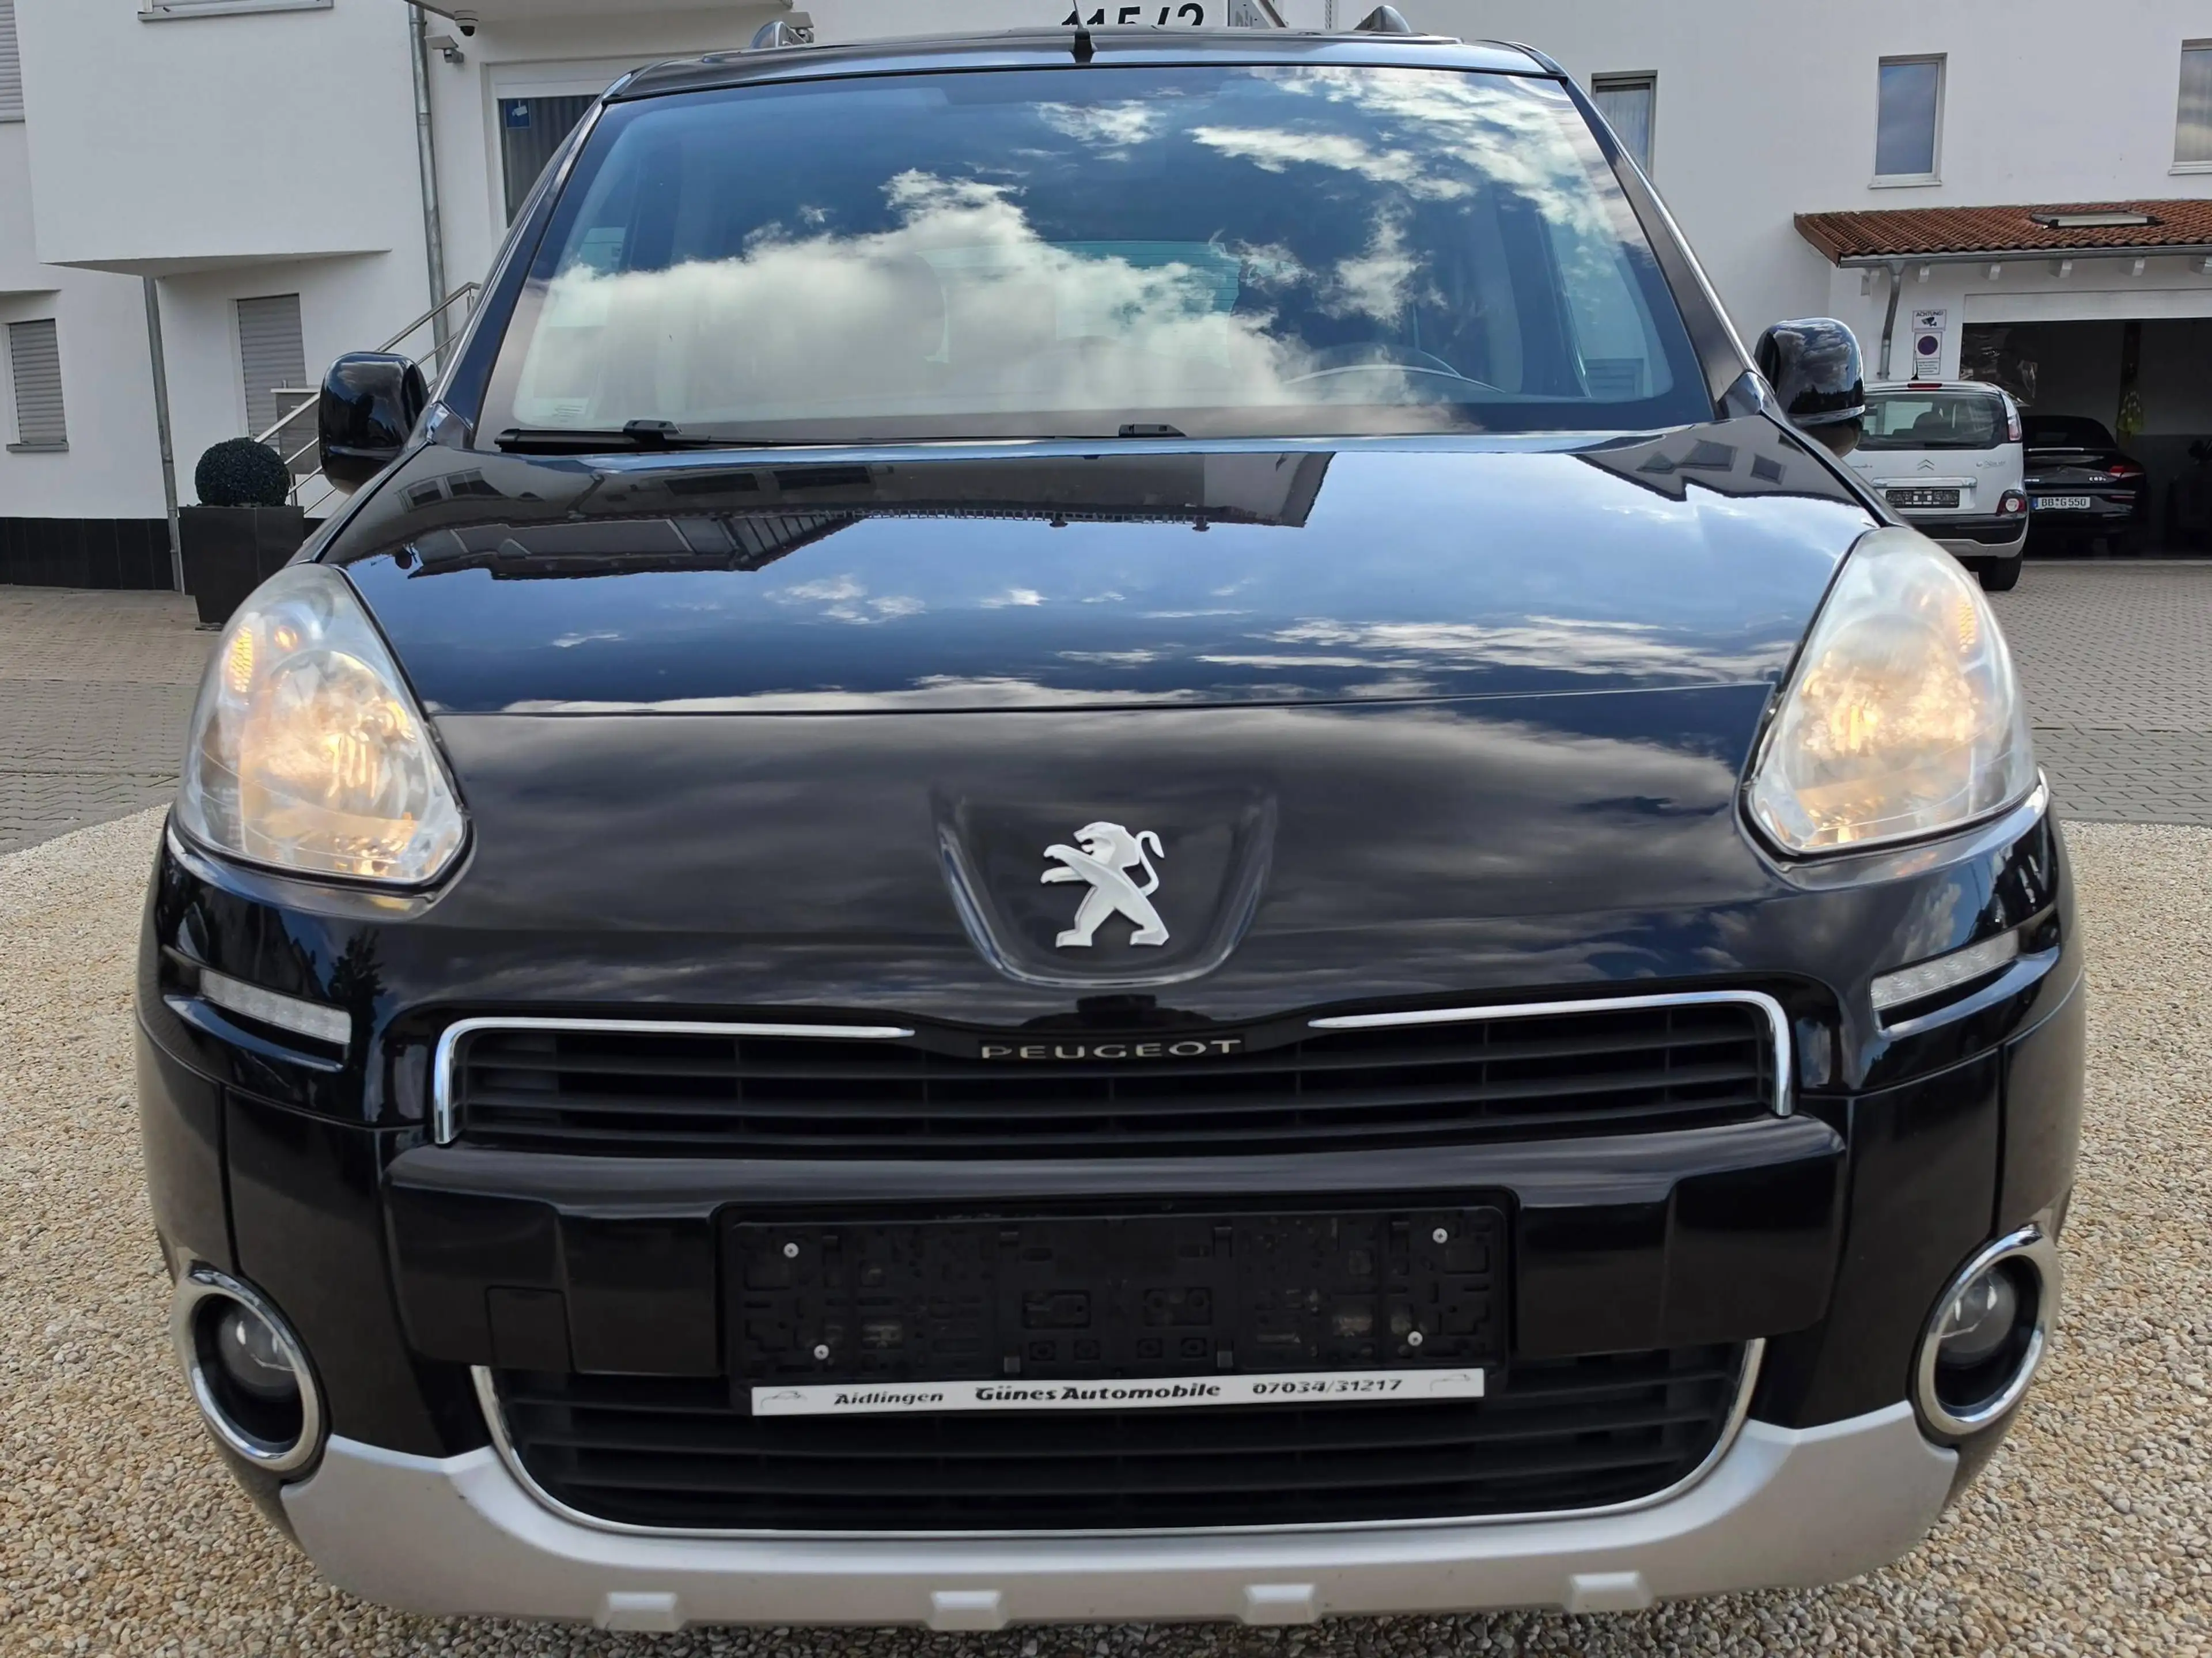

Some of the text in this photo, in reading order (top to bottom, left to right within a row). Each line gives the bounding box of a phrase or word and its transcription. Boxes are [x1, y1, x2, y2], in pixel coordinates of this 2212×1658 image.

[2041, 498, 2054, 507] BB
[981, 1039, 1241, 1059] PEUGEOT
[834, 1378, 1403, 1405] Aidlingen Günes Automobile 07034/31217
